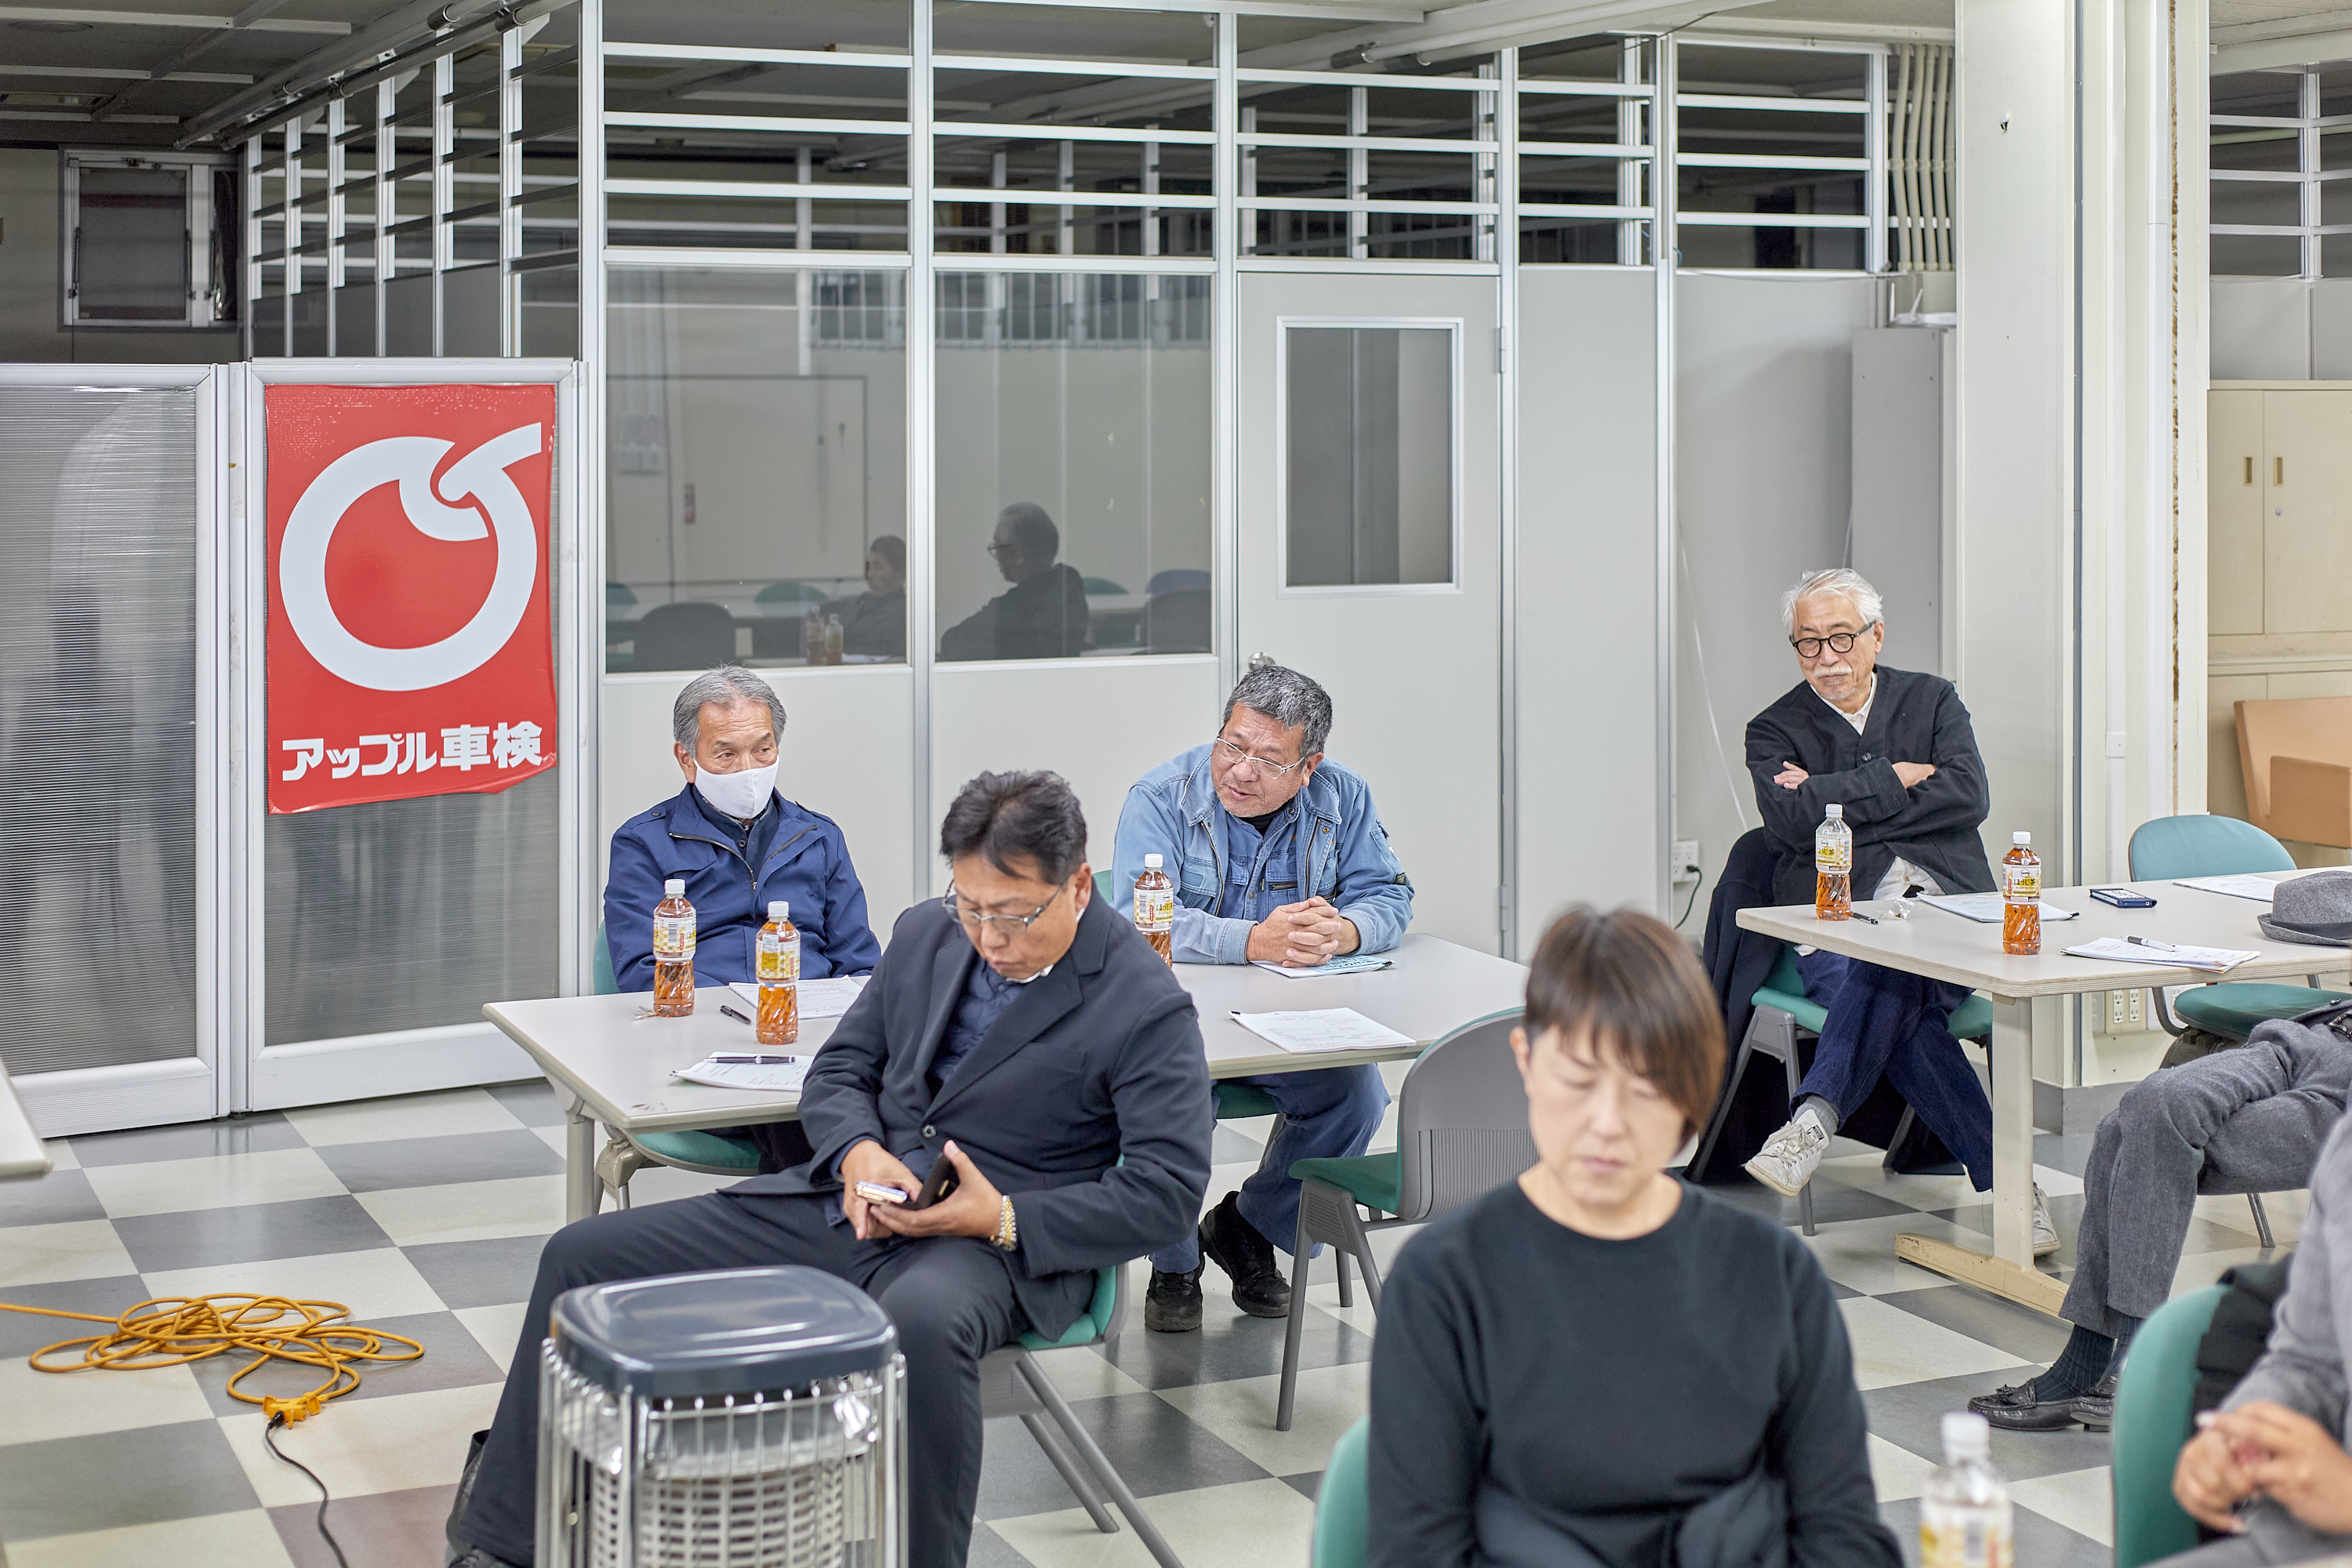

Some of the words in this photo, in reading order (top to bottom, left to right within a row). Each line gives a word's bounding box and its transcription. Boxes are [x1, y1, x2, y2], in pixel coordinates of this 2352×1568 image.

[282, 720, 543, 781] アップル車検
